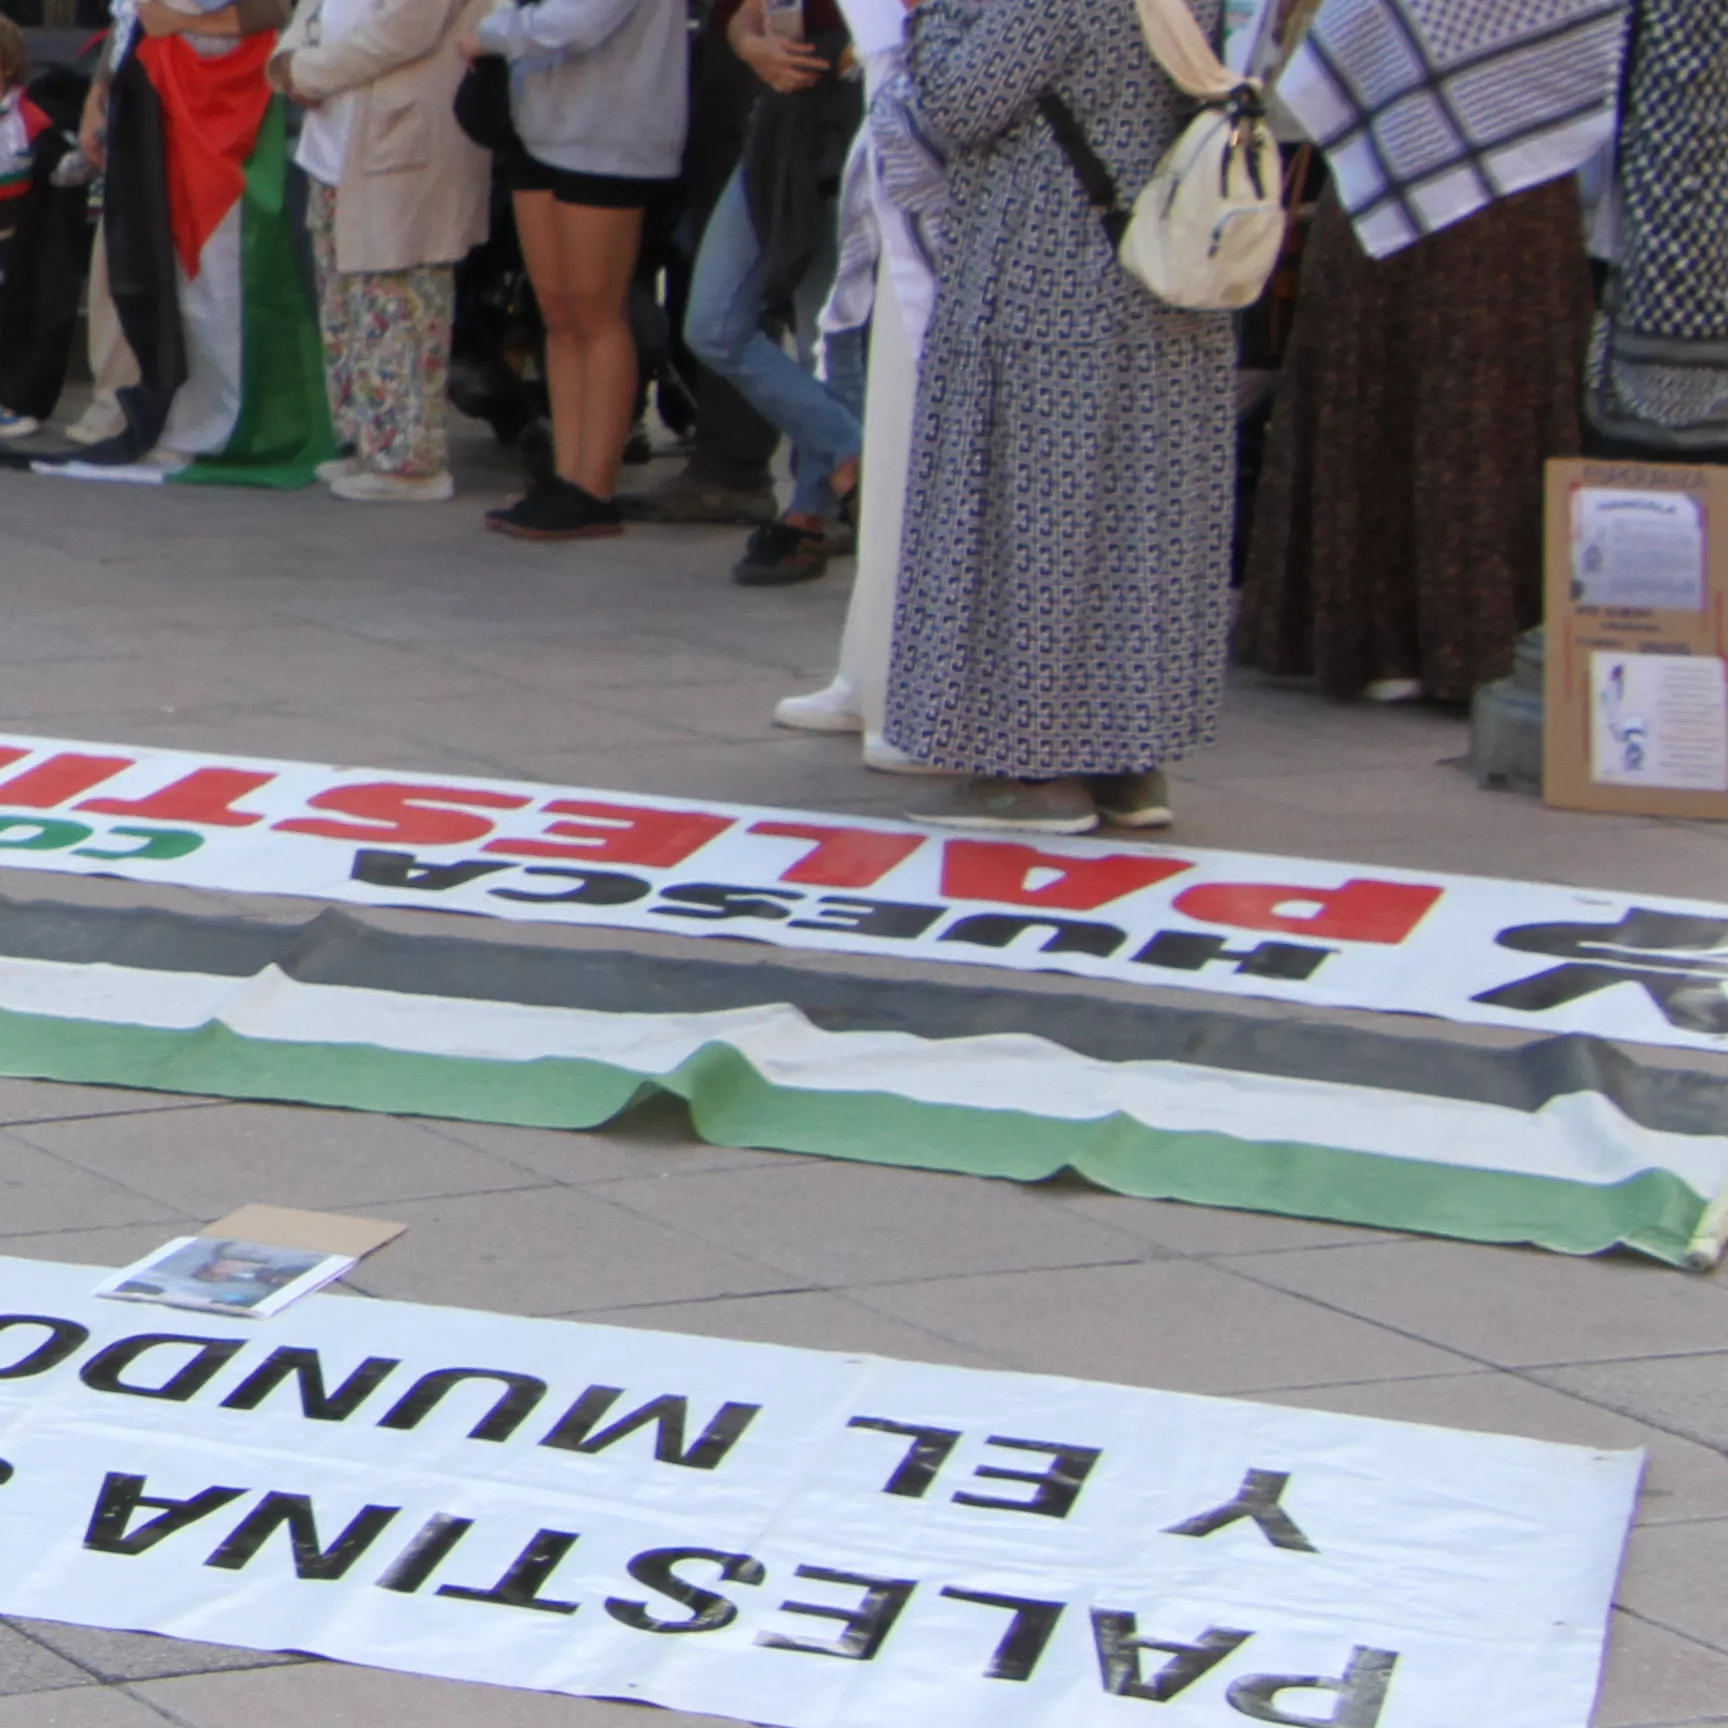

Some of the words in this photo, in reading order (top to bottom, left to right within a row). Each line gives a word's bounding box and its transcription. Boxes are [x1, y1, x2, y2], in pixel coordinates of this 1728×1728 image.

[350, 848, 1336, 981] HUESCA
[846, 1414, 1103, 1519] EL
[1159, 1467, 1321, 1554] Y
[82, 1471, 1401, 1728] PALESTINA
